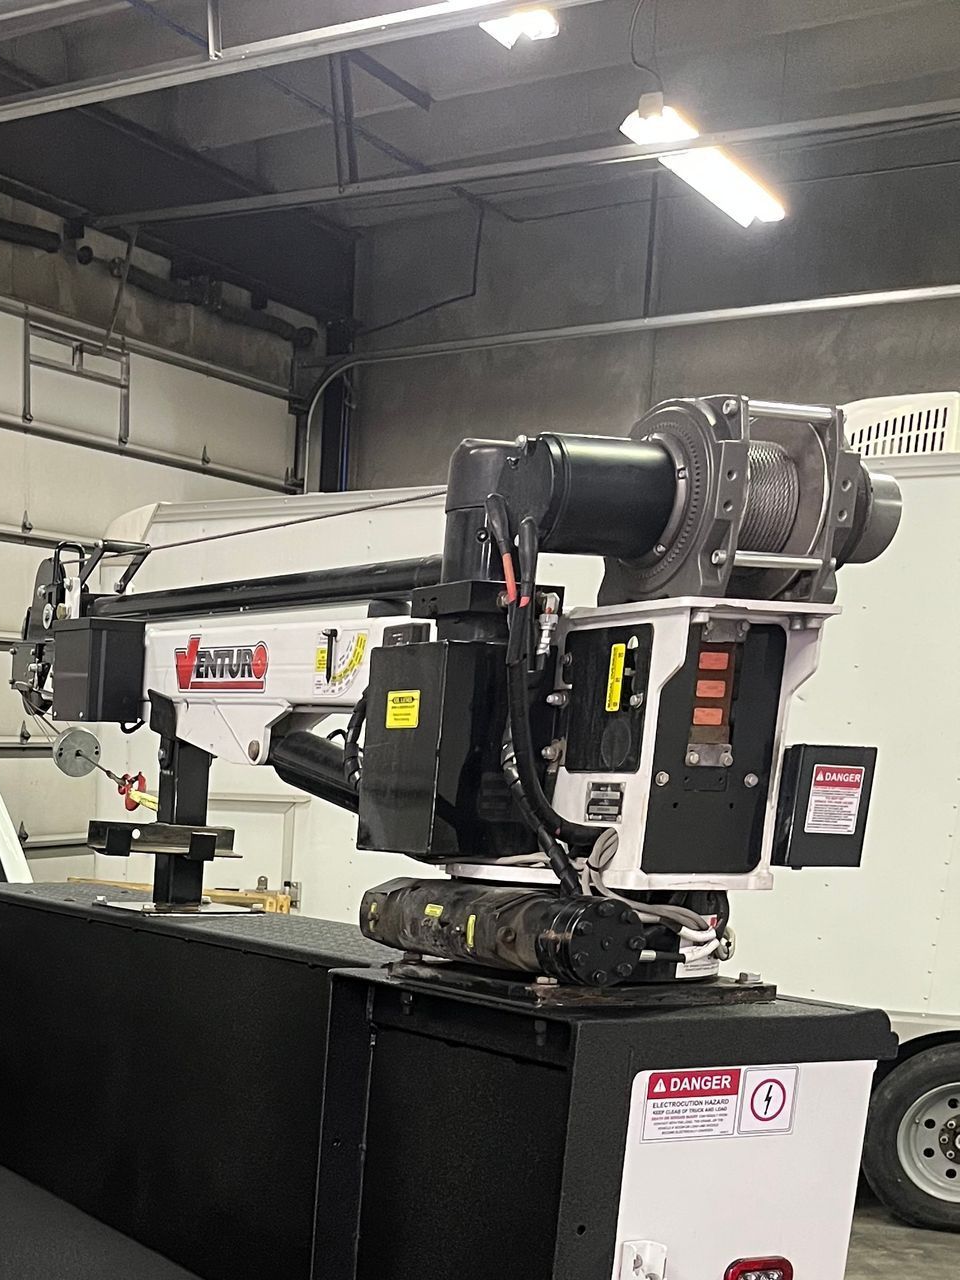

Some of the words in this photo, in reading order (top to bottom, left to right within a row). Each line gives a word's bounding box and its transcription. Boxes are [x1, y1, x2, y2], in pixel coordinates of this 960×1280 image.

[176, 637, 267, 689] VENTURO
[825, 772, 861, 783] DANGER
[670, 1075, 732, 1092] DANGER
[653, 1100, 703, 1108] ELECTROCUTION
